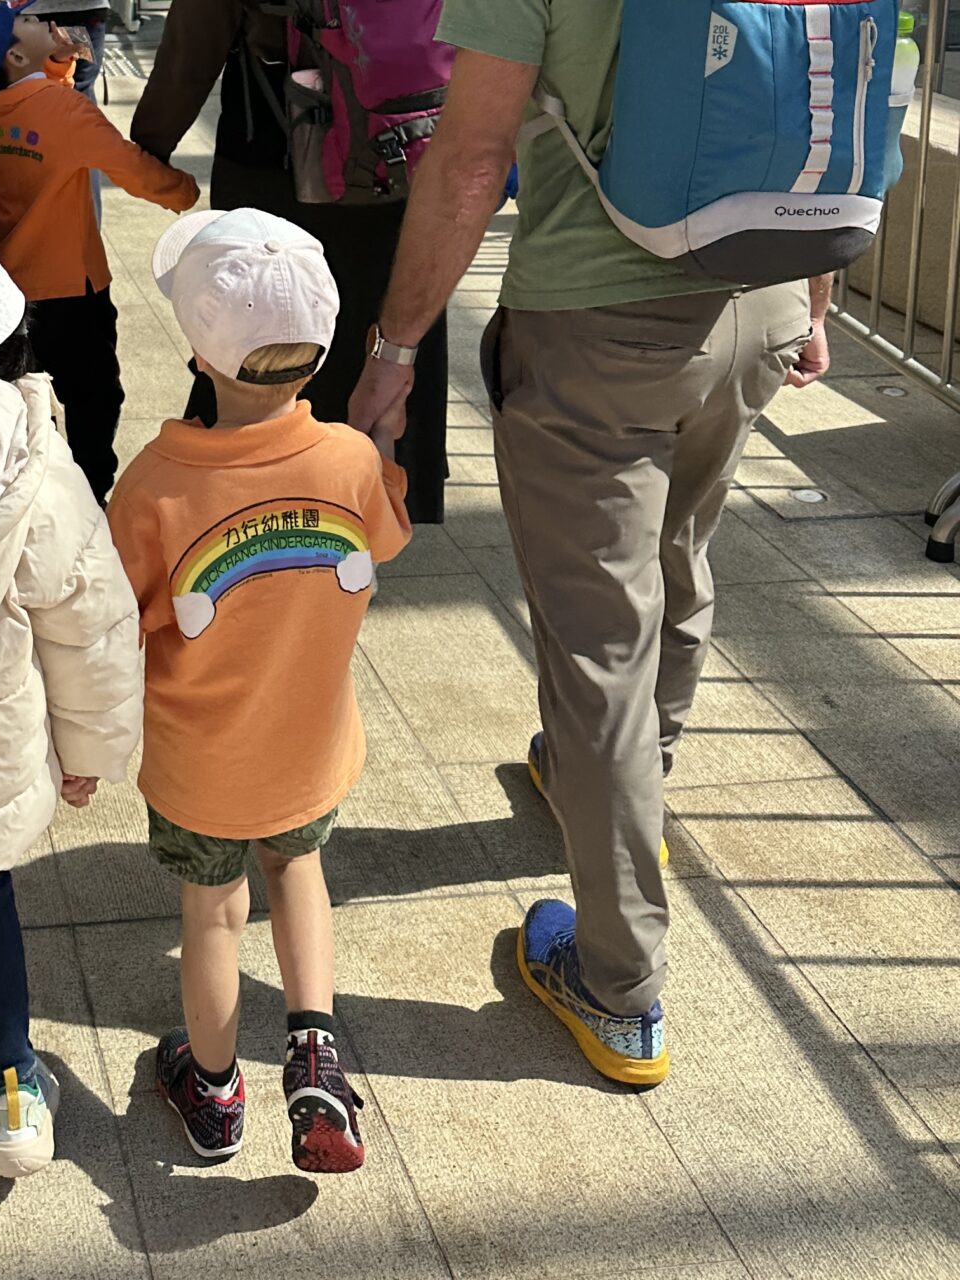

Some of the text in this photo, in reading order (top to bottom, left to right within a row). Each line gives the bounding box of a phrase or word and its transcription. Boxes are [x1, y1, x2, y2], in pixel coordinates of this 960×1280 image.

[712, 24, 730, 35] 20L
[712, 34, 730, 45] ICE
[774, 205, 840, 217] Quechua
[221, 508, 320, 549] 力行幼稚園
[225, 543, 258, 571] HANG
[259, 533, 351, 556] KINDERGARTEN
